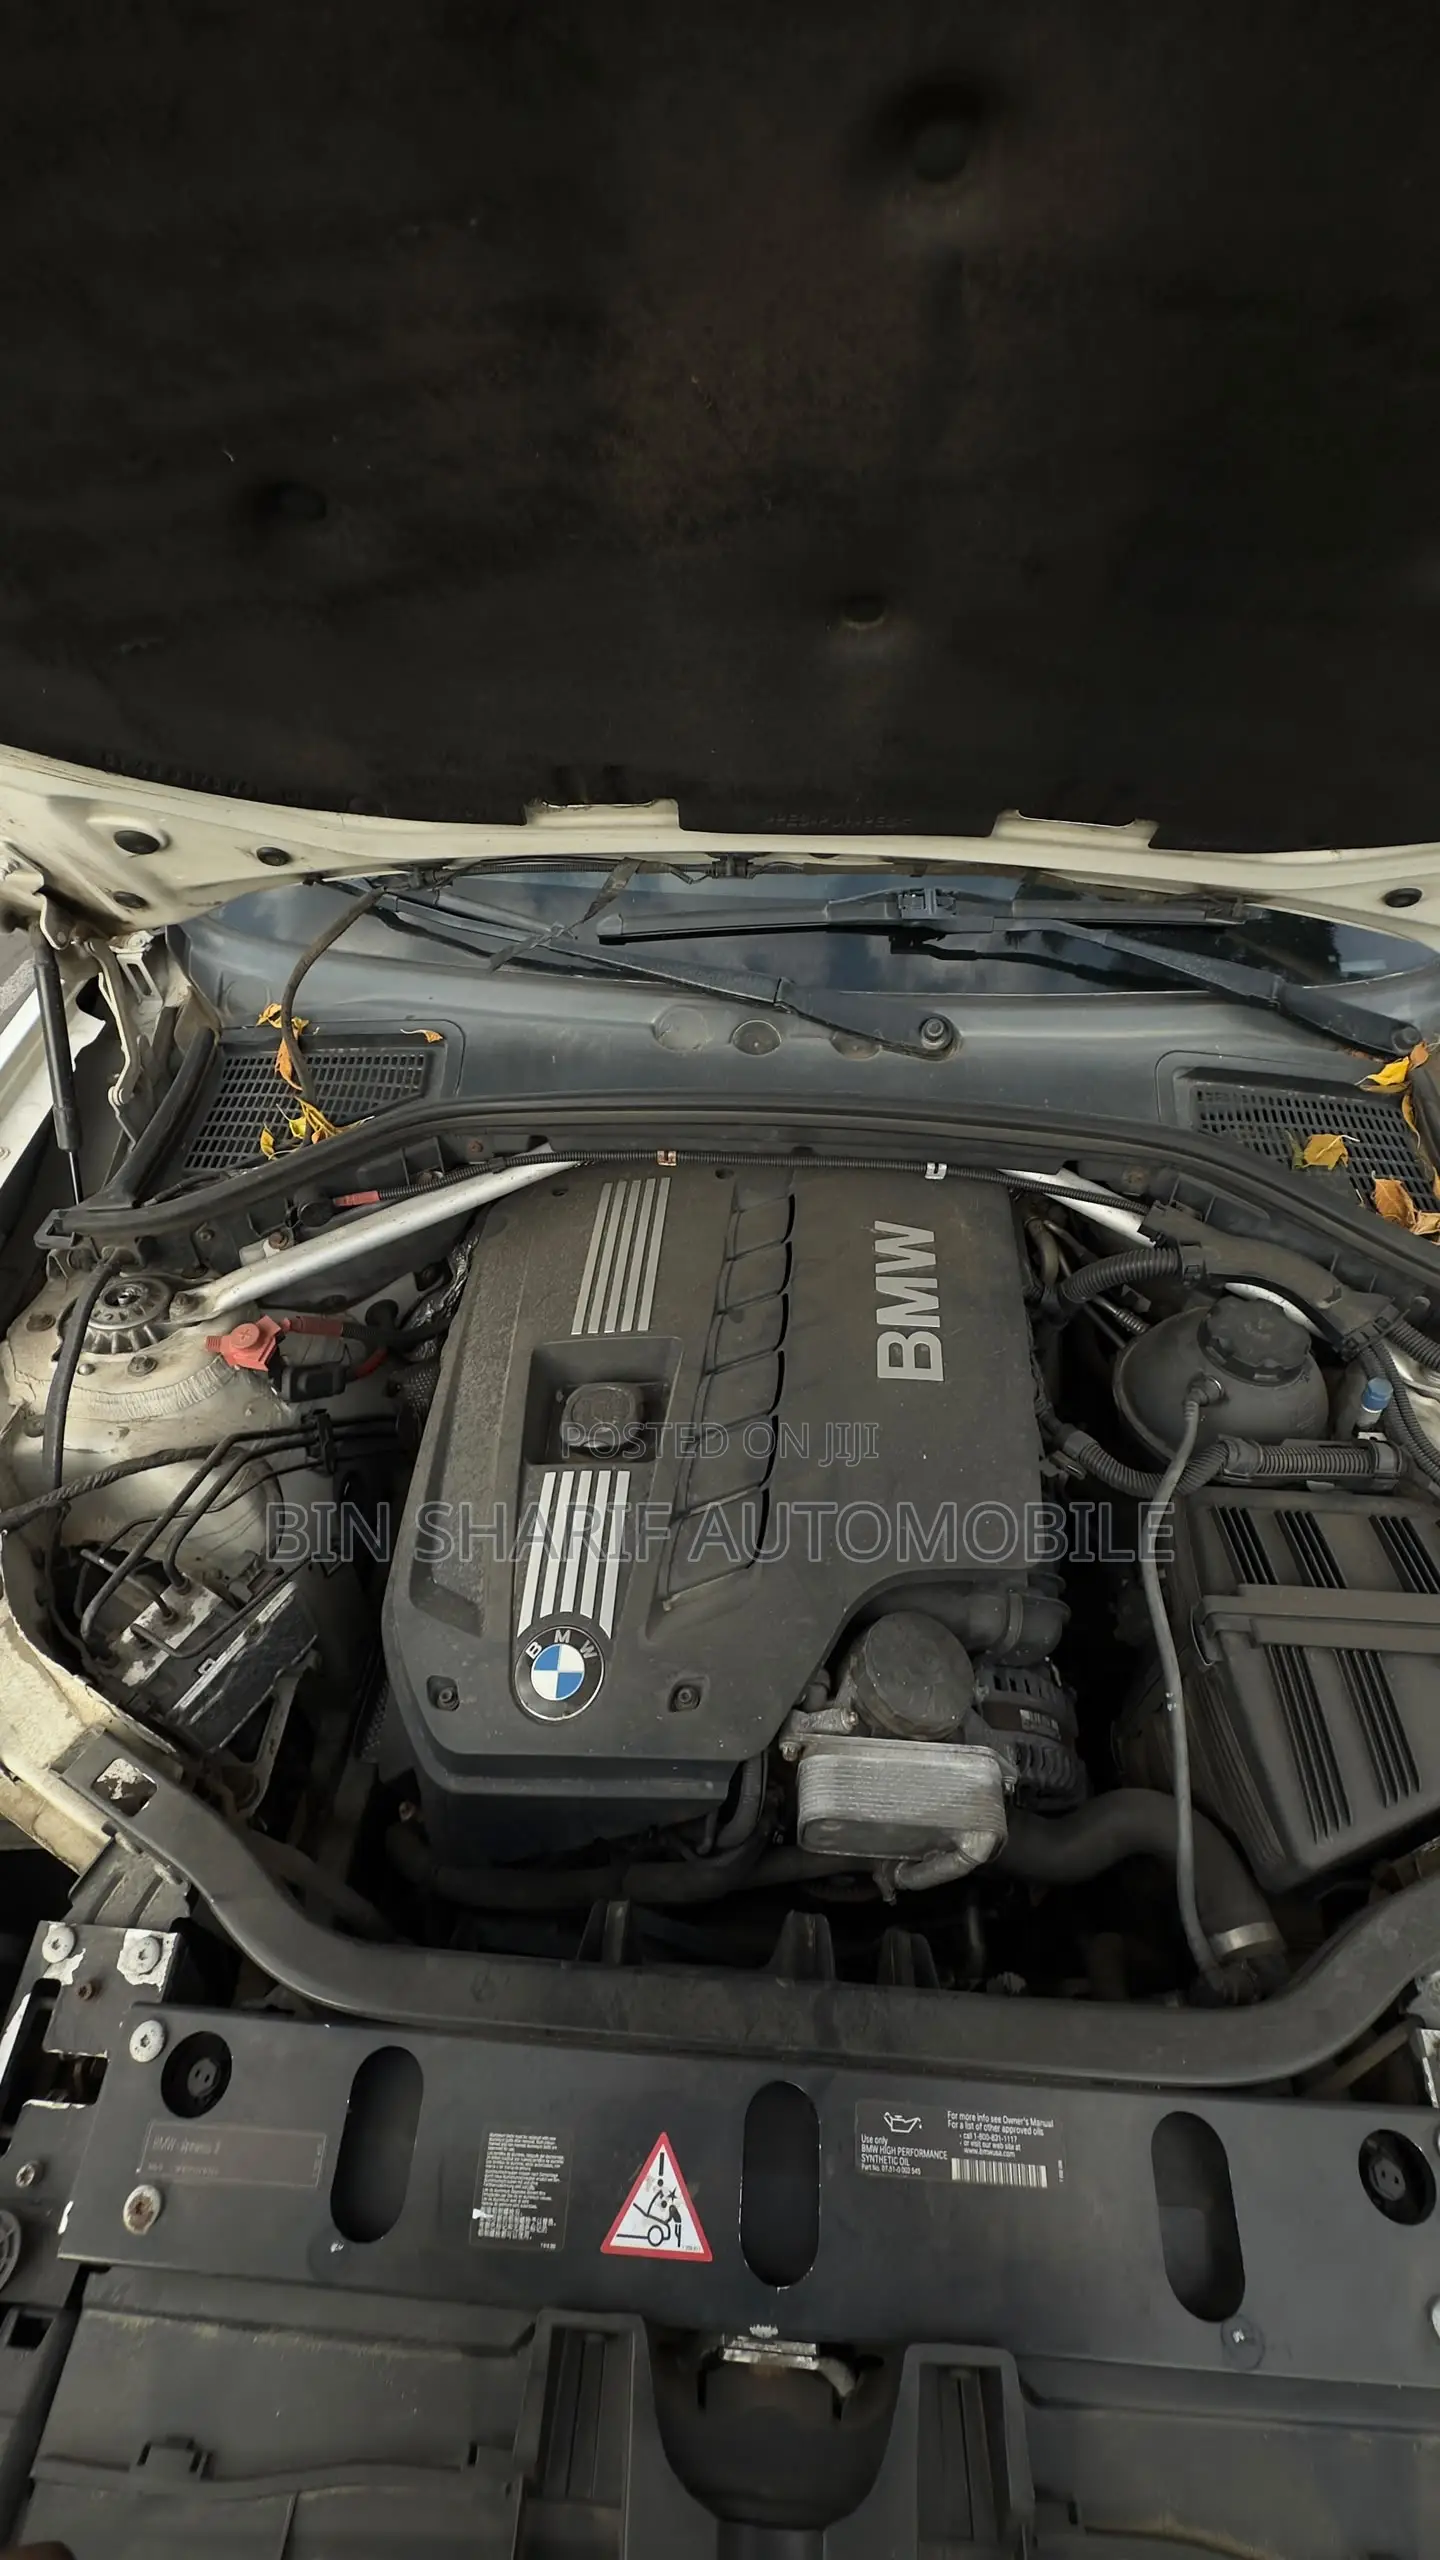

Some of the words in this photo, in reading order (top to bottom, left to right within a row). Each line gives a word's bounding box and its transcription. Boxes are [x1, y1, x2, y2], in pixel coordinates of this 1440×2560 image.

[874, 1220, 944, 1381] BMW
[525, 1629, 598, 1660] BMW
[947, 2111, 958, 2120] For
[959, 2113, 976, 2122] more
[977, 2113, 990, 2123] info
[991, 2115, 1002, 2124] see
[1002, 2115, 1029, 2126] Owner's
[1030, 2117, 1054, 2128] Manual
[947, 2120, 958, 2129] For
[965, 2121, 974, 2130] list
[975, 2122, 982, 2131] of
[983, 2123, 1001, 2132] other
[1001, 2125, 1032, 2136] approved
[861, 2134, 875, 2144] Use
[875, 2136, 888, 2147] only
[861, 2144, 878, 2154] BMW
[879, 2145, 897, 2156] HIGH
[897, 2147, 948, 2160] PERFORMANCE
[861, 2153, 899, 2165] SYNTHETIC
[899, 2157, 910, 2166] OIL
